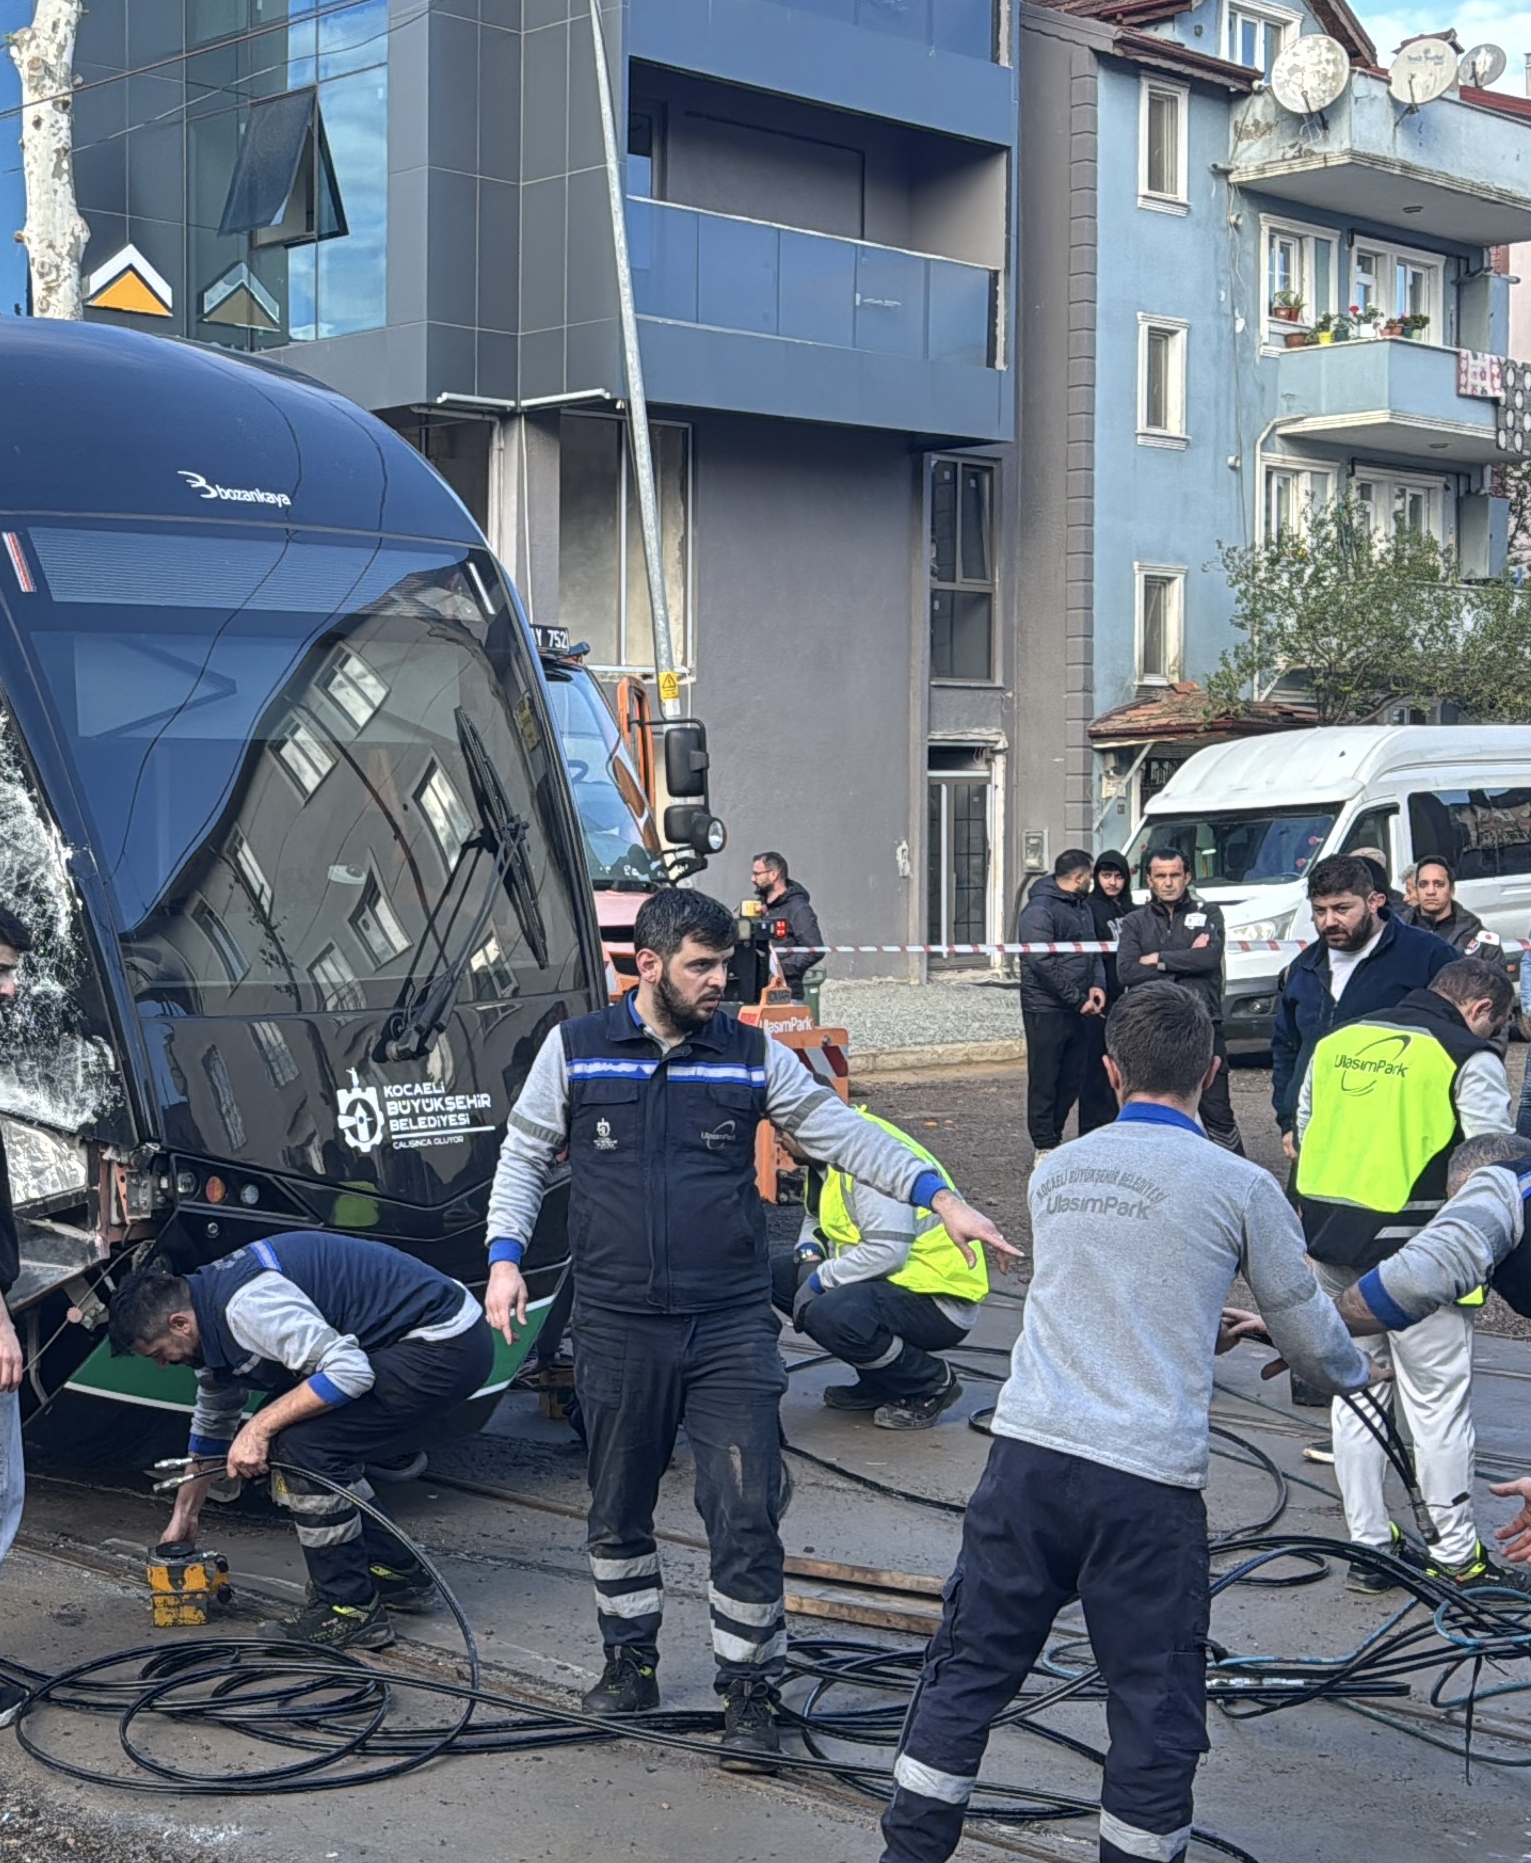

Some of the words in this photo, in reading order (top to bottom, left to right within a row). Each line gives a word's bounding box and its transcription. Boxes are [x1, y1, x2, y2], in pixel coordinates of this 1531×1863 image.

[215, 484, 292, 508] bozankaya
[383, 1081, 445, 1098] KOCAELİ
[386, 1093, 491, 1116] BÜYÜKŞEHİR
[389, 1113, 471, 1132] BELEDİYESİ
